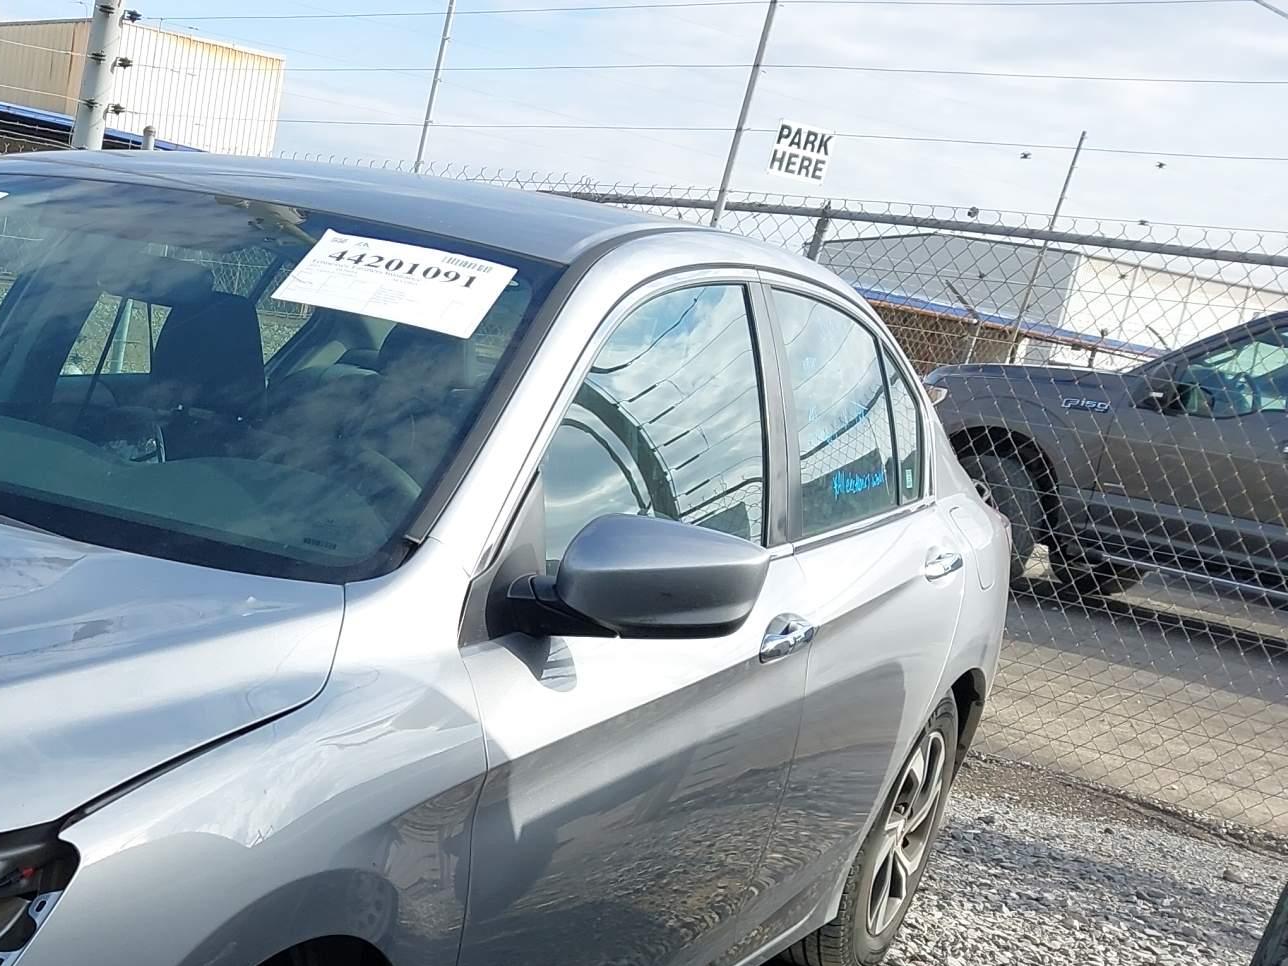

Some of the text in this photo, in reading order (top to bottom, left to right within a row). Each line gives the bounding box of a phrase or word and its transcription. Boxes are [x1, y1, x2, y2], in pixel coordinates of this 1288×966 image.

[776, 124, 834, 156] PARK
[769, 149, 826, 180] HERE
[328, 249, 477, 289] 44201091
